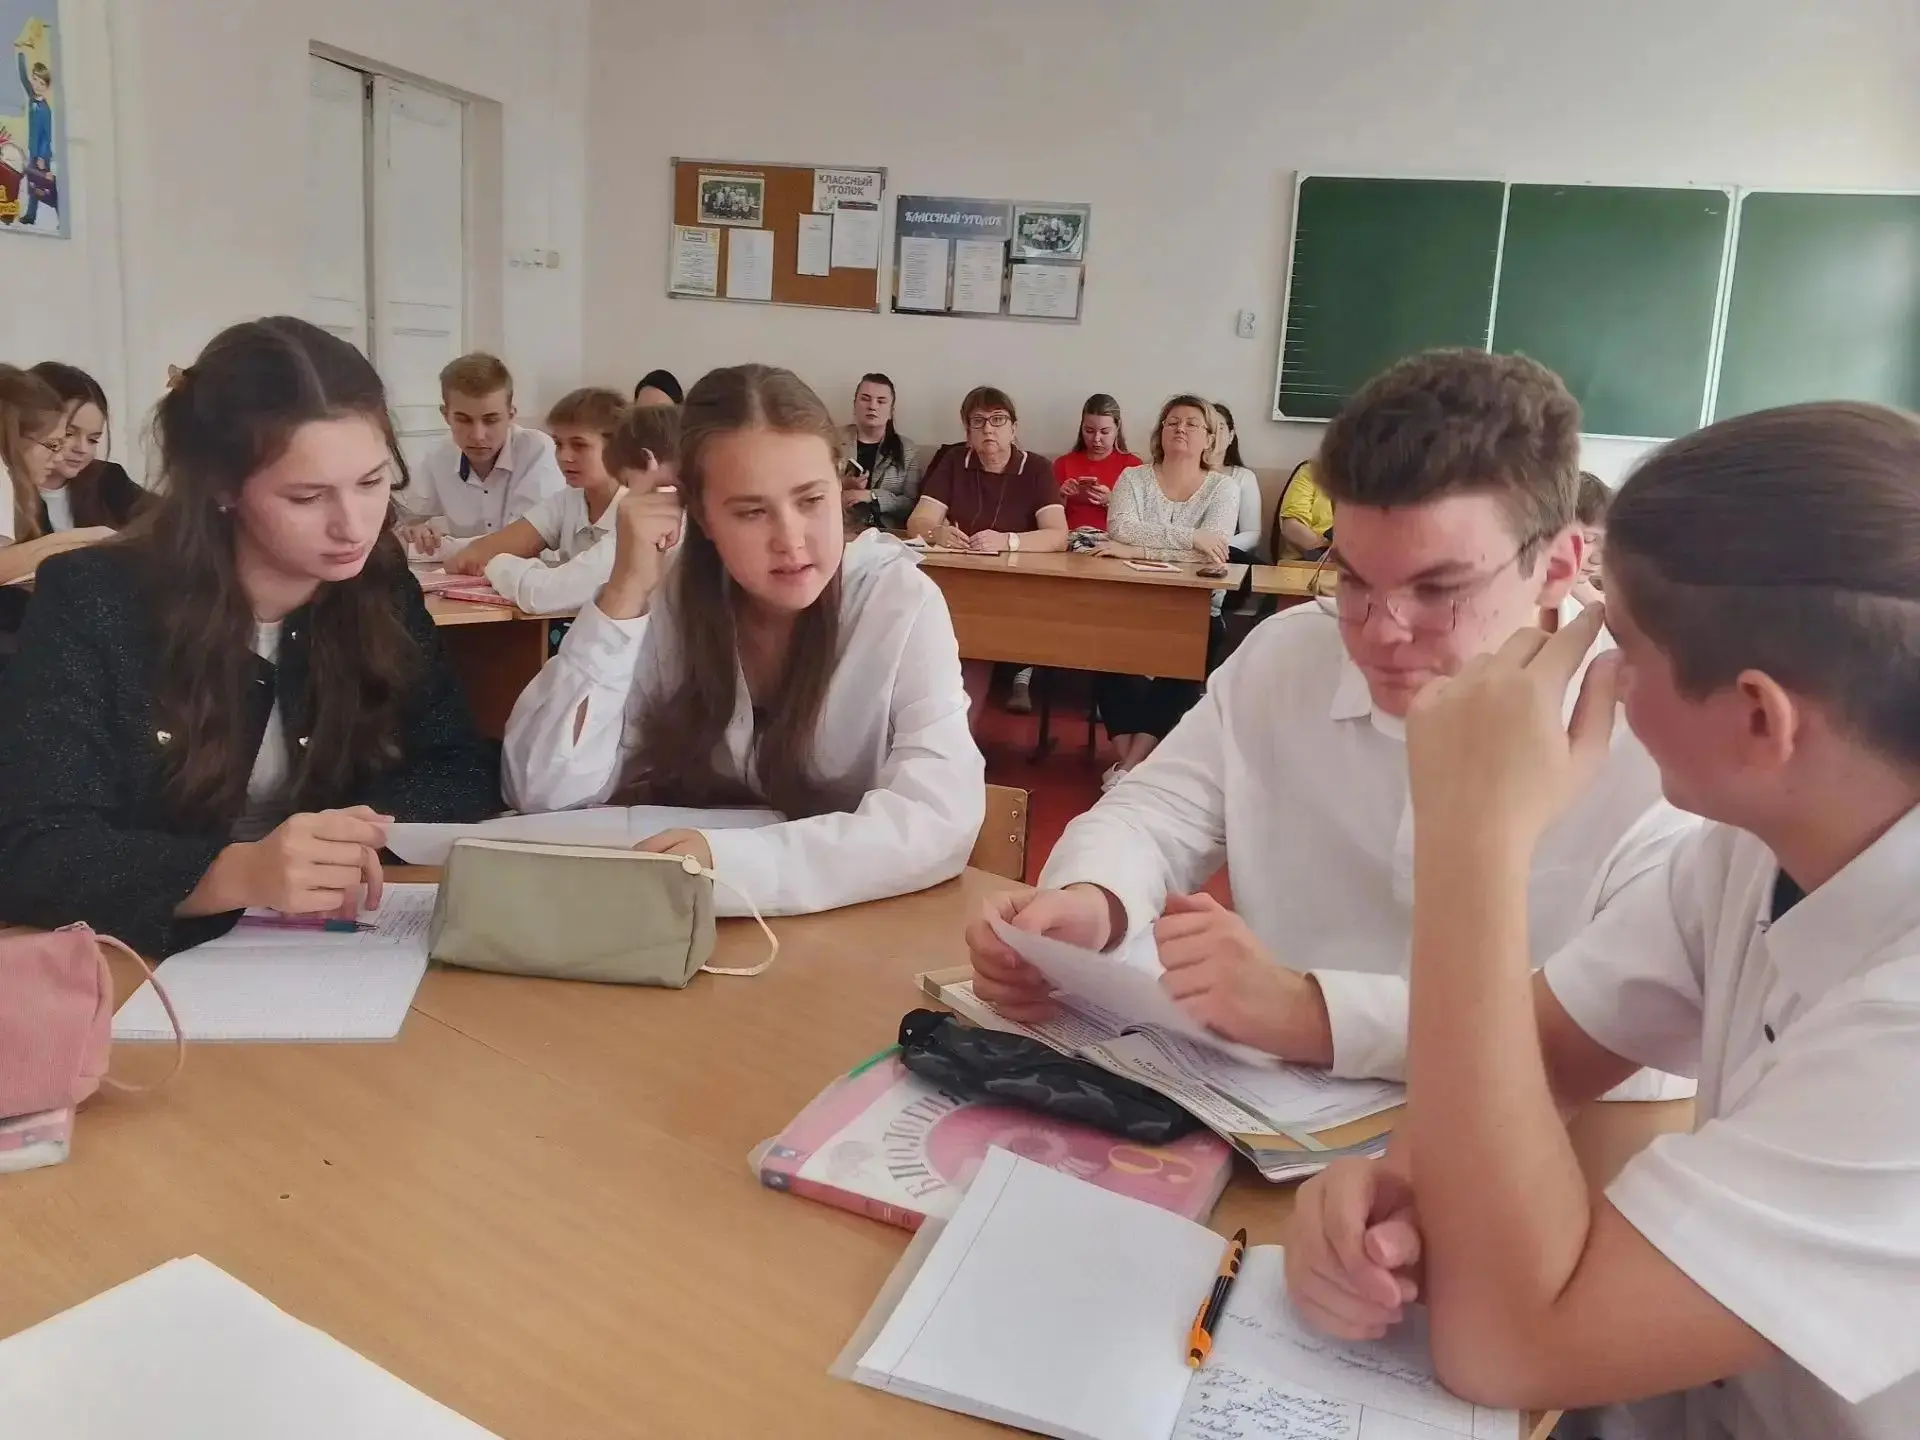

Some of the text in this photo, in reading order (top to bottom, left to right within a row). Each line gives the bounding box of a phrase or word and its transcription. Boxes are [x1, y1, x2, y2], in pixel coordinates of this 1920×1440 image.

[818, 174, 873, 187] КЛАССНЫЙ
[827, 185, 864, 196] УГОЛОК
[904, 211, 960, 224] КЛАССНЫЙ
